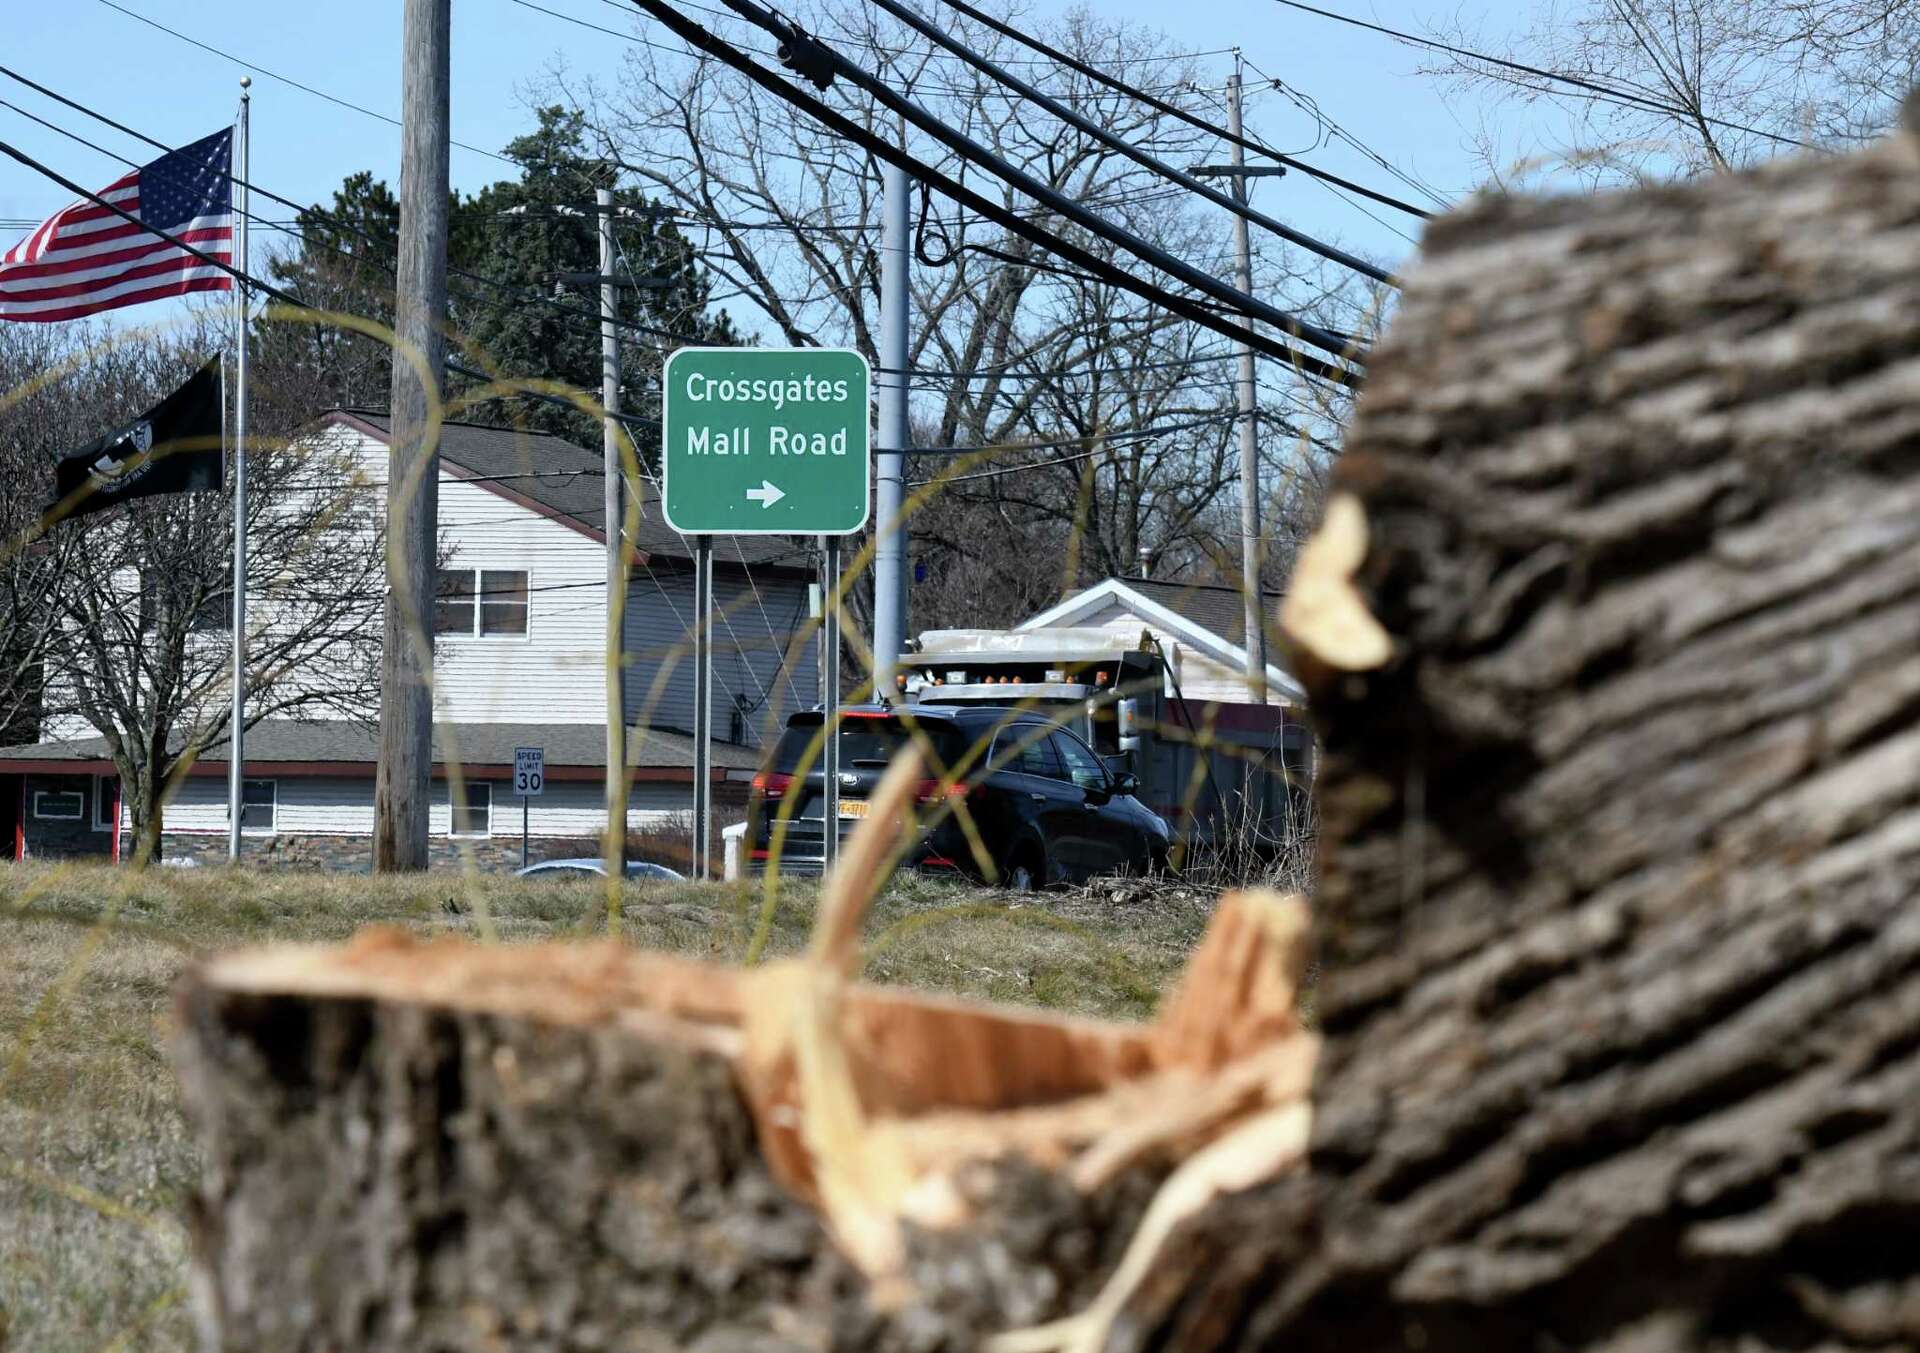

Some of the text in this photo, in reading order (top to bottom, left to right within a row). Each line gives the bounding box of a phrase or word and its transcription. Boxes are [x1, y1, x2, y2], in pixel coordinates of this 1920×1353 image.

[686, 372, 848, 410] Crossgates
[687, 426, 847, 455] Mall Road
[518, 752, 541, 760] SPEED
[520, 762, 539, 770] LIMIT
[518, 773, 540, 790] 30
